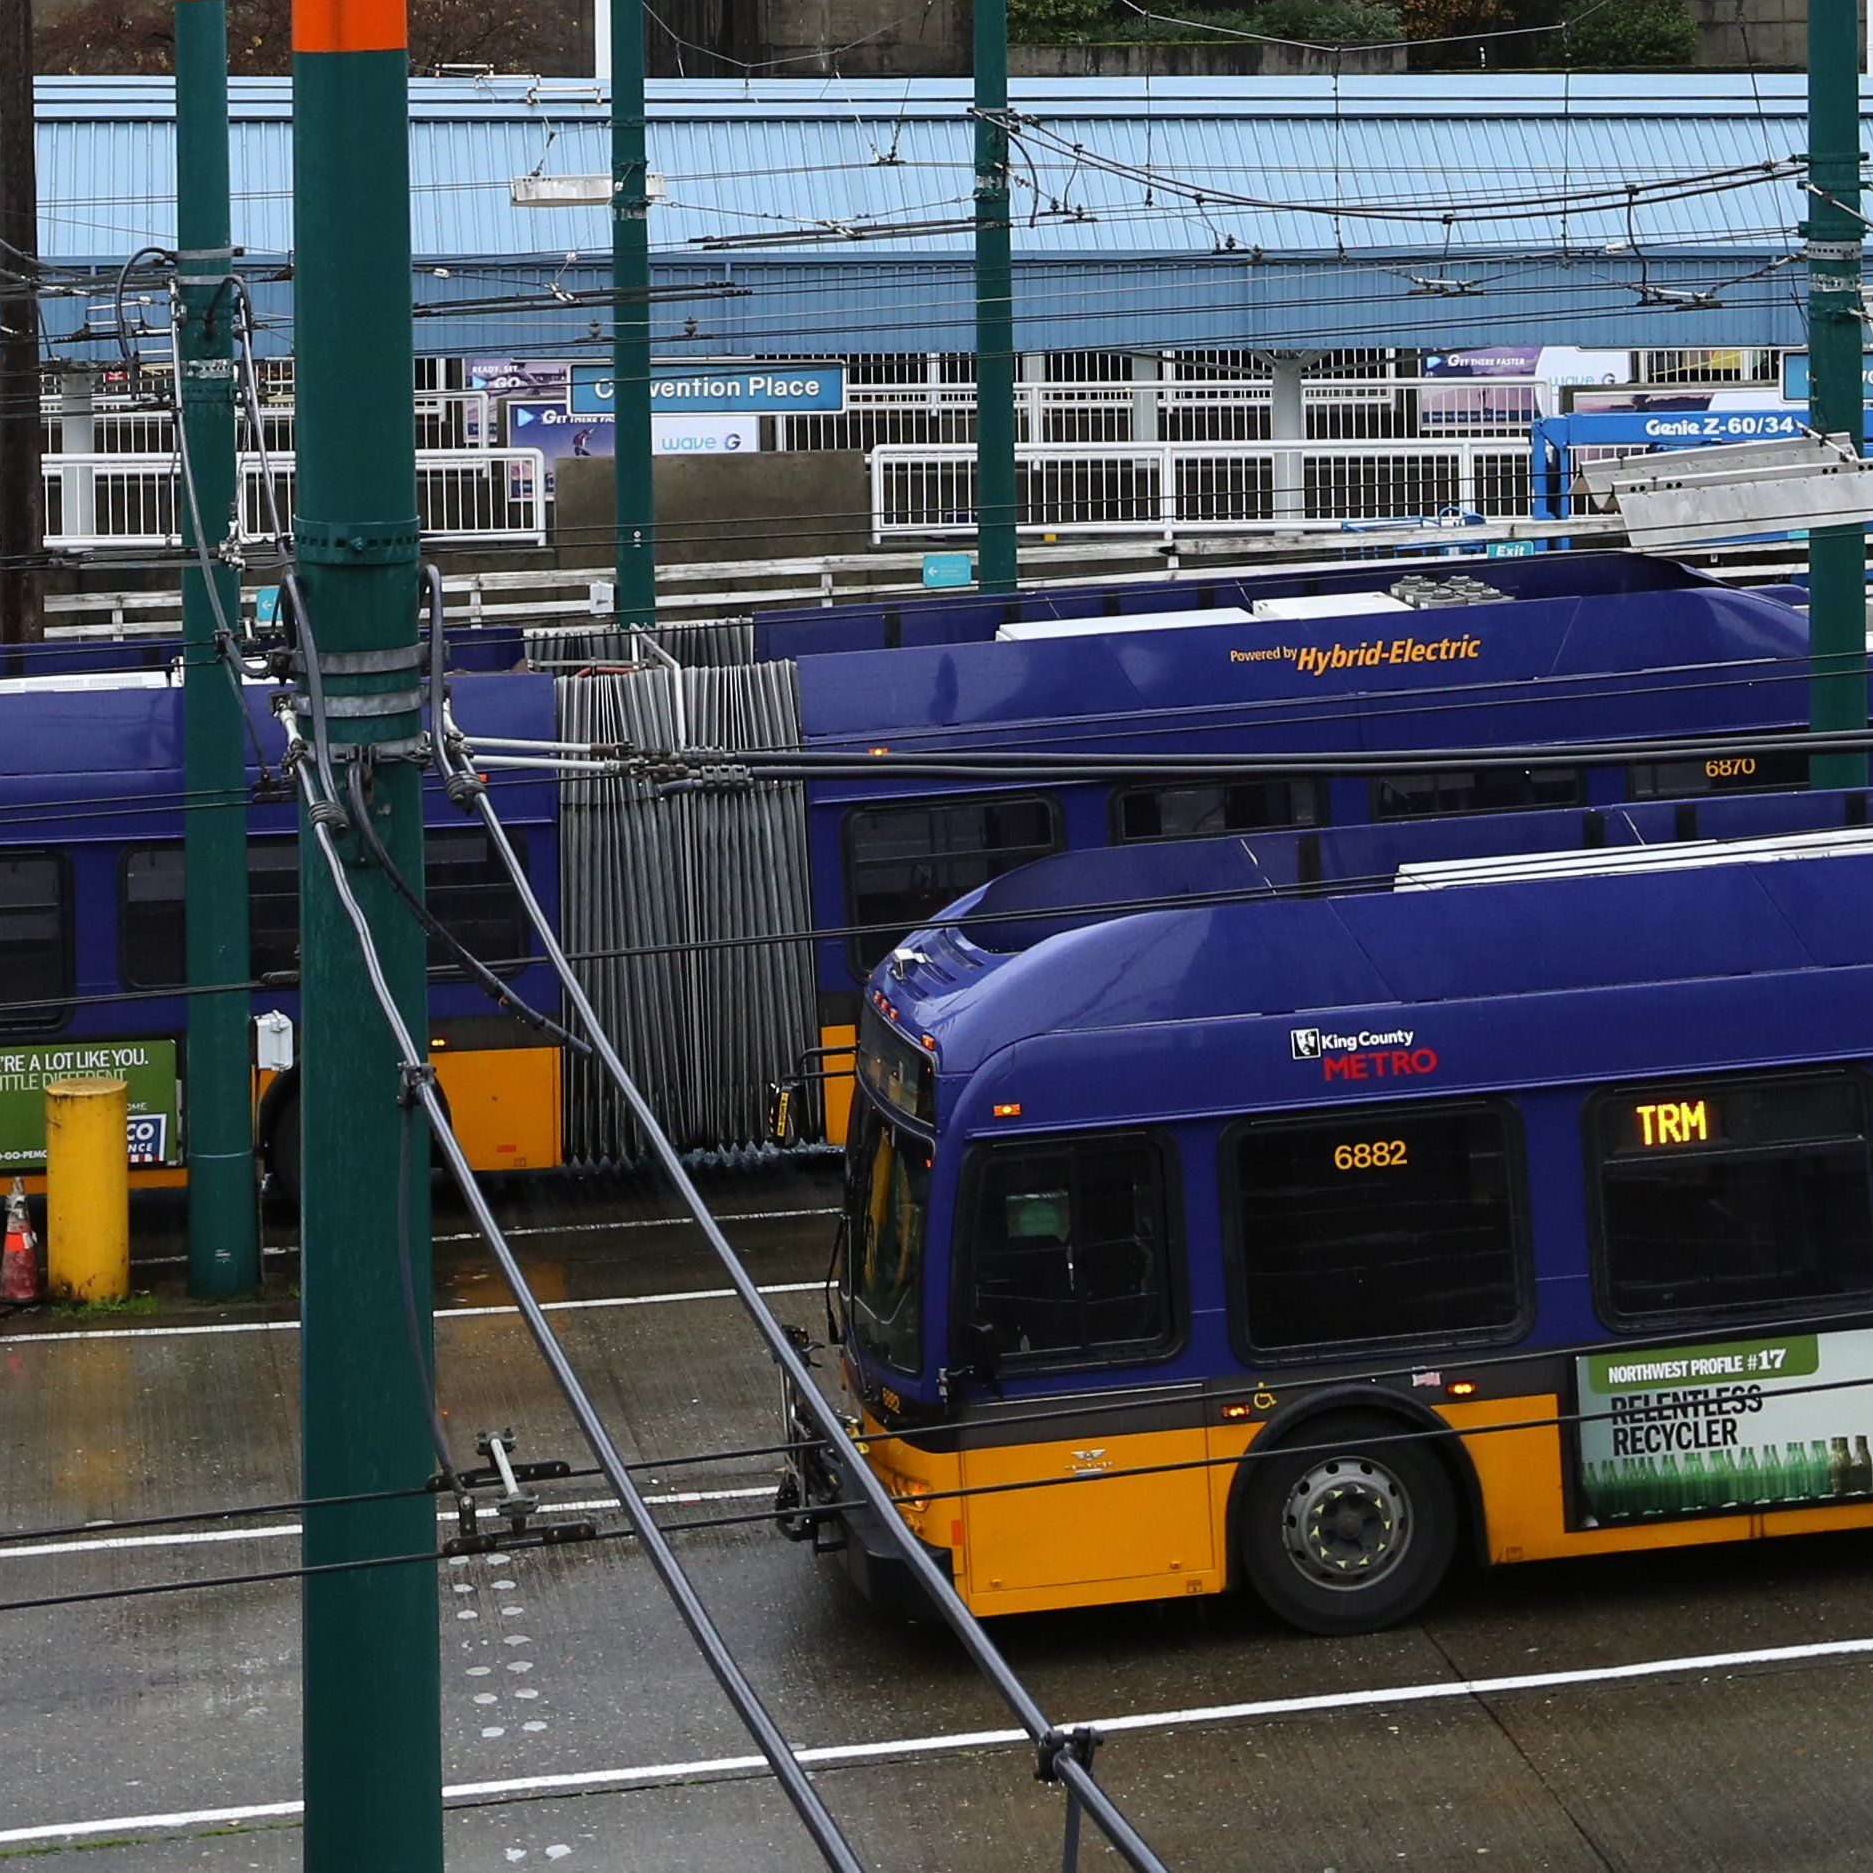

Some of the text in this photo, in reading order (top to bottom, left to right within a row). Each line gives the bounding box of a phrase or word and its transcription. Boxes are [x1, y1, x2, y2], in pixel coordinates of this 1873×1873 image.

[1448, 354, 1525, 367] GET THERE FASTER
[495, 376, 521, 388] GO
[594, 376, 820, 400] Cvention Place
[542, 409, 567, 424] GET
[1645, 417, 1795, 437] Genie Z-60/34
[661, 433, 741, 451] wave G
[1496, 545, 1525, 558] Exit
[1230, 633, 1481, 676] Powered by Hybrid-Electric
[1705, 758, 1756, 778] 6870
[1322, 1029, 1414, 1051] King County
[29, 1054, 41, 1071] A
[45, 1052, 73, 1070] LOT
[76, 1050, 110, 1069] LIKE
[111, 1048, 149, 1067] YOU.
[1323, 1048, 1439, 1081] METRO
[1636, 1100, 1707, 1145] TRM
[1334, 1140, 1408, 1170] 6882
[1608, 1348, 1787, 1383] NORTHWEST PROFILE #17
[1611, 1384, 1763, 1425] RELENTLESS
[1613, 1418, 1739, 1457] RECYCLER
